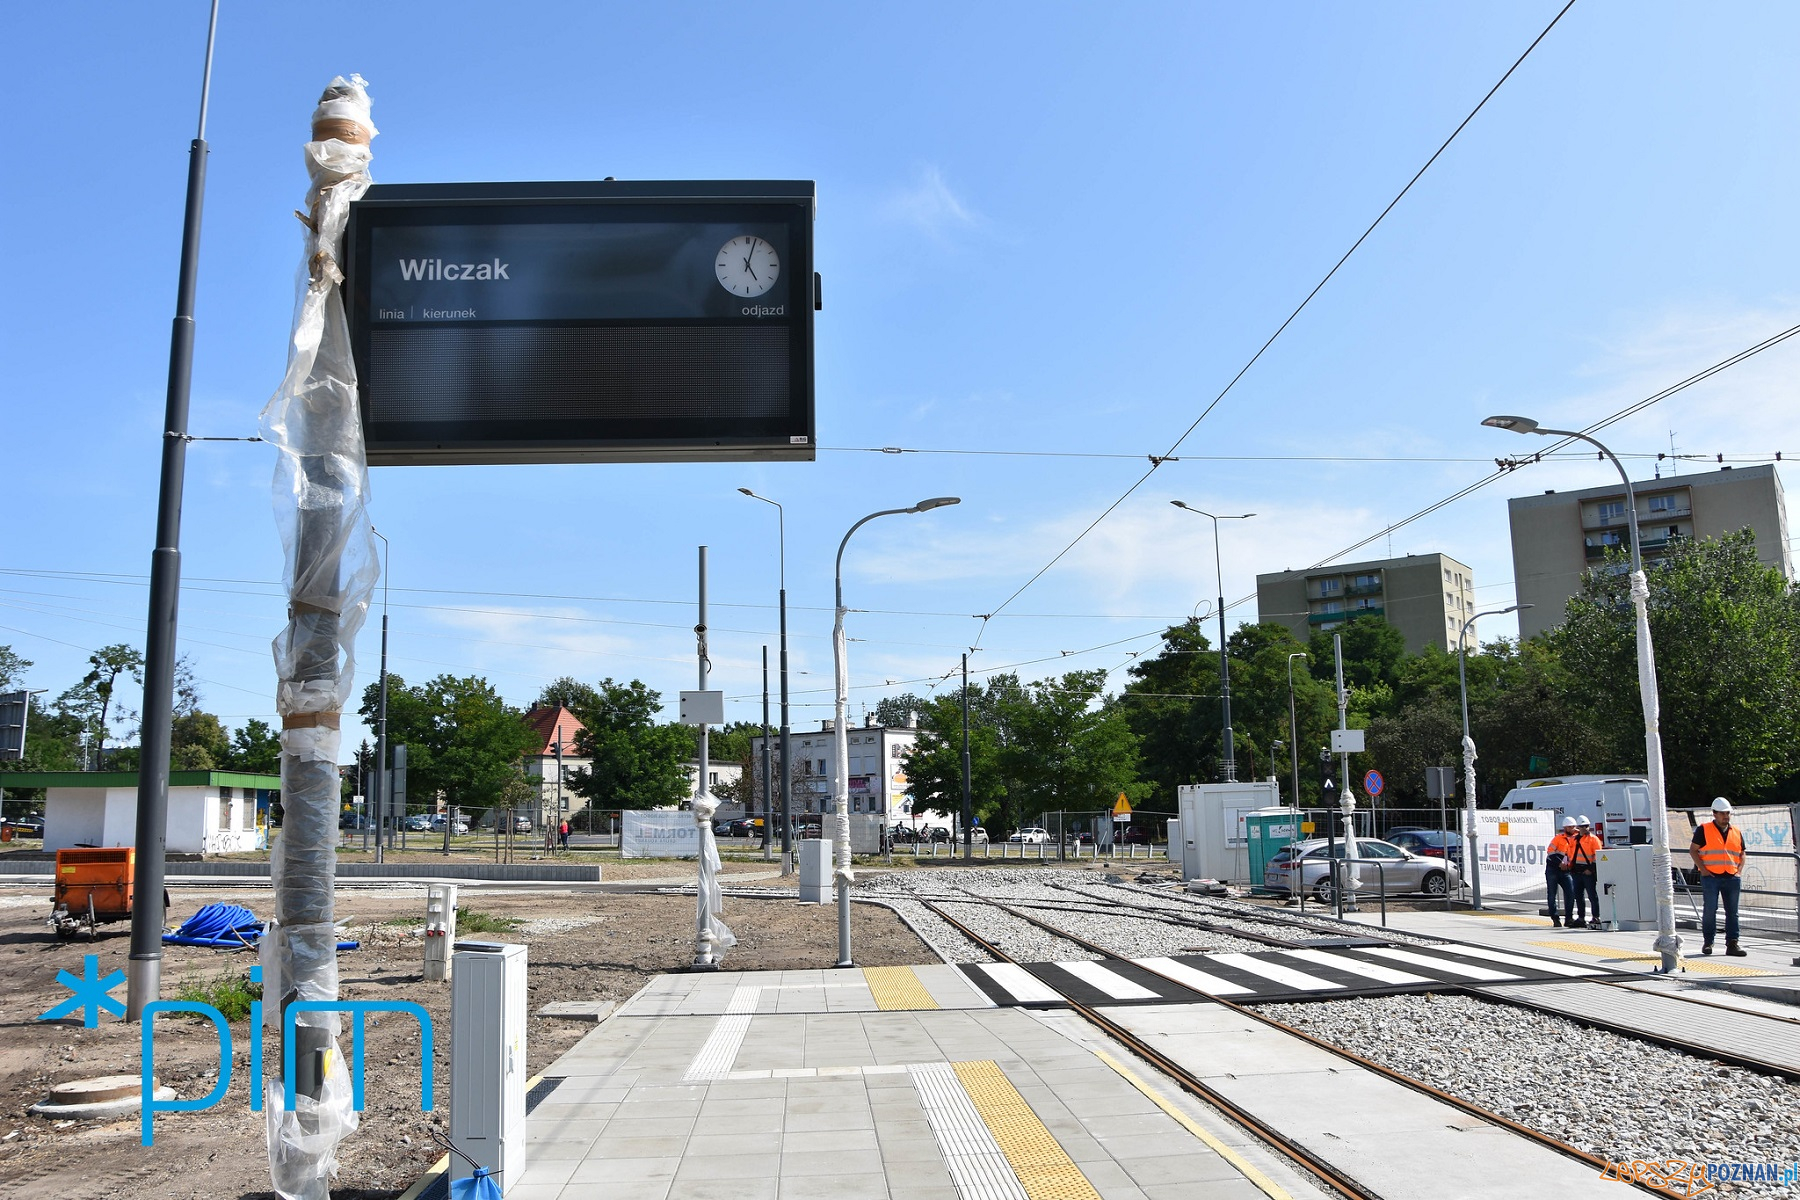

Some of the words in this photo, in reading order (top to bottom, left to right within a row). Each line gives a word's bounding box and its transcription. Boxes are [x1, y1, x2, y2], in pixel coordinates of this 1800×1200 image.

[399, 258, 510, 281] Wilczak
[379, 308, 405, 319] linia
[423, 307, 476, 319] kierunek
[741, 304, 784, 318] odjazd
